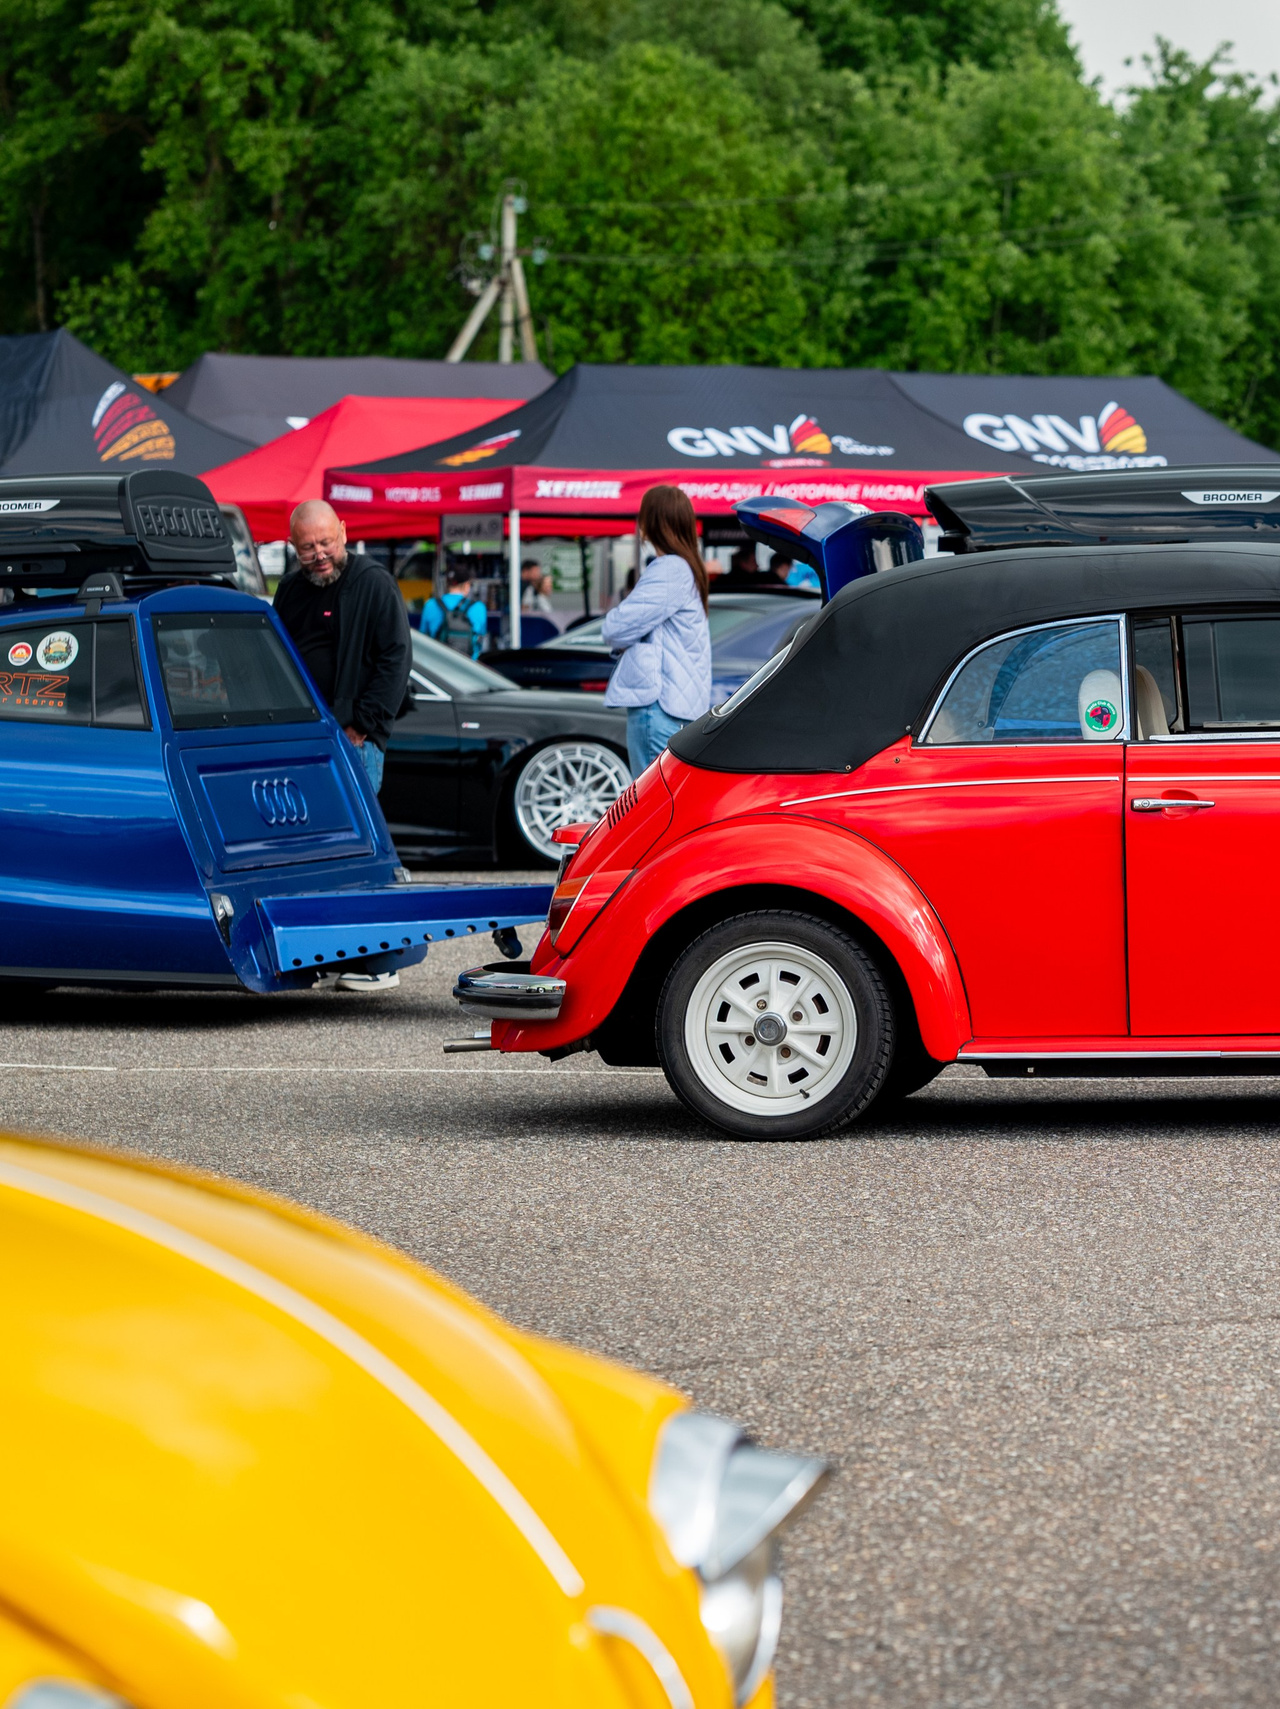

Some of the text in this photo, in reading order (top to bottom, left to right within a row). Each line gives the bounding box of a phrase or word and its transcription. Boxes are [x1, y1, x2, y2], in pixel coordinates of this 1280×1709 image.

[667, 425, 791, 457] GNV
[963, 413, 1101, 452] GNV
[0, 502, 42, 511] OOMER
[1203, 493, 1262, 502] BROOMER
[137, 505, 224, 538] BROOMER
